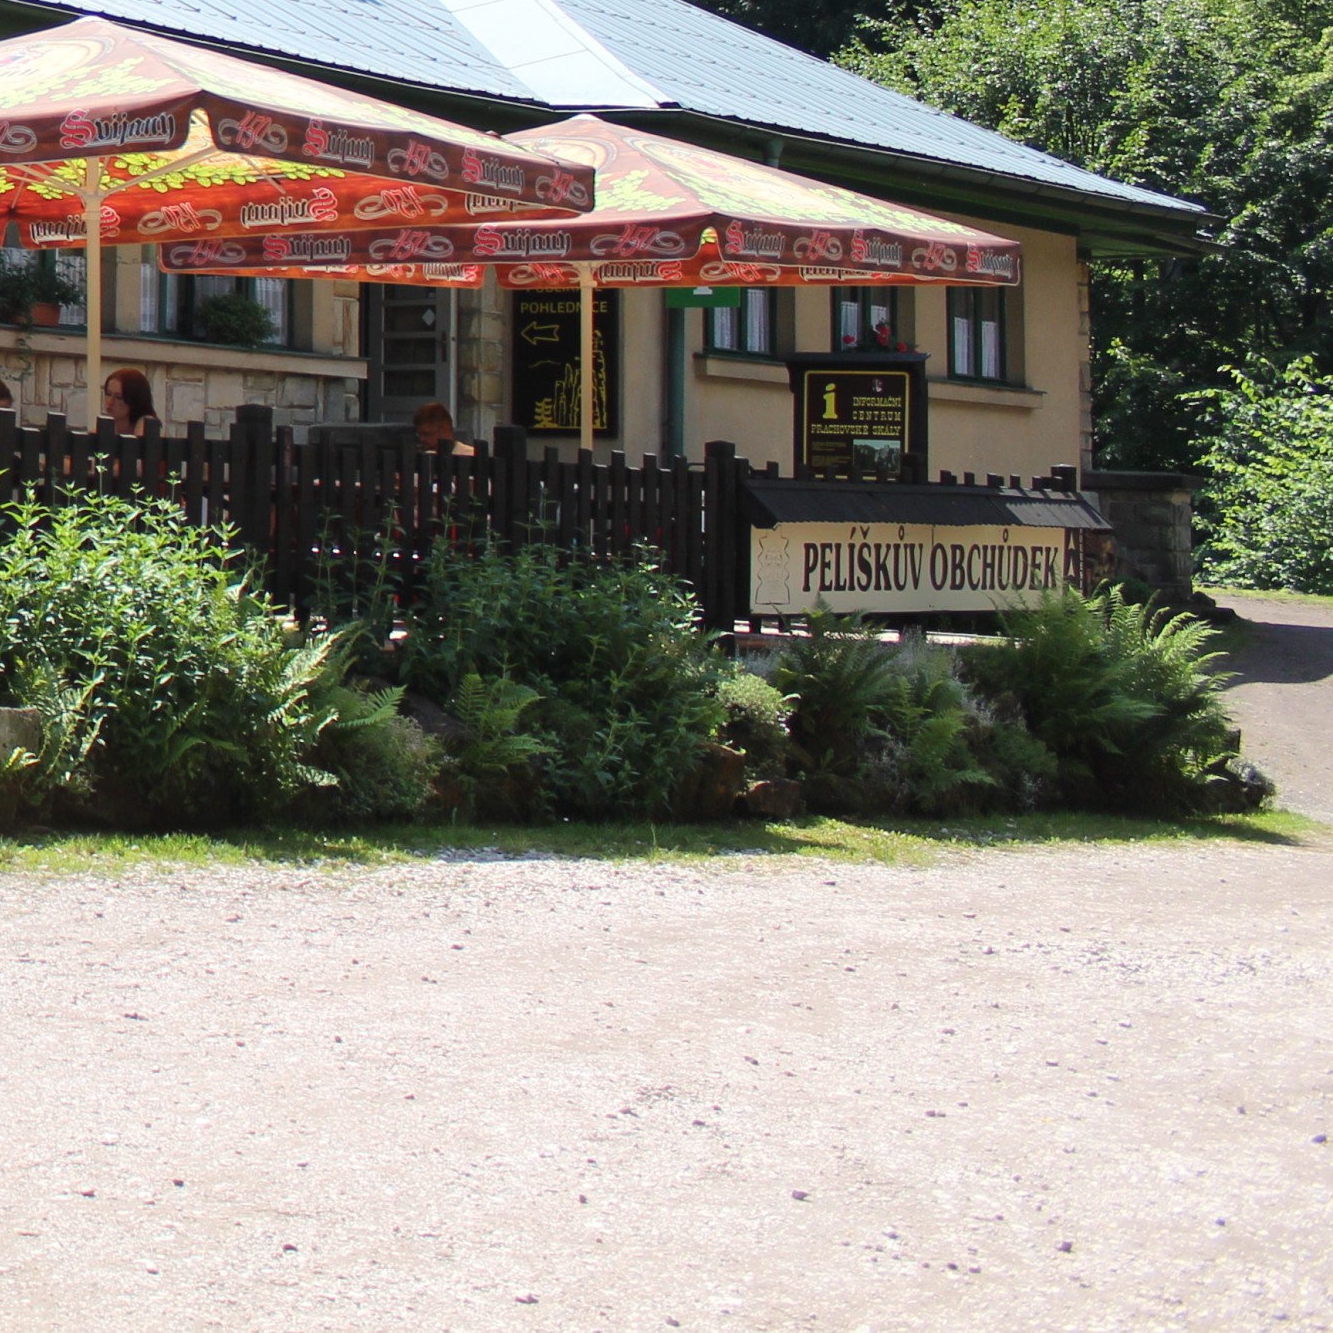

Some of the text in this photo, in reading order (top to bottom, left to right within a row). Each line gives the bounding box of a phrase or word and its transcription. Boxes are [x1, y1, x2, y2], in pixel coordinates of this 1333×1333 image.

[60, 108, 175, 150] Svijany
[303, 117, 375, 168] Svijany
[263, 233, 351, 262] Svijany
[474, 222, 572, 258] Svijany
[520, 300, 608, 314] POHLEDNCE
[852, 410, 901, 421] CENTRUM
[872, 424, 901, 436] SKÁLY
[802, 525, 1059, 592] PELÍŠKŮV OBCHŮDEK
